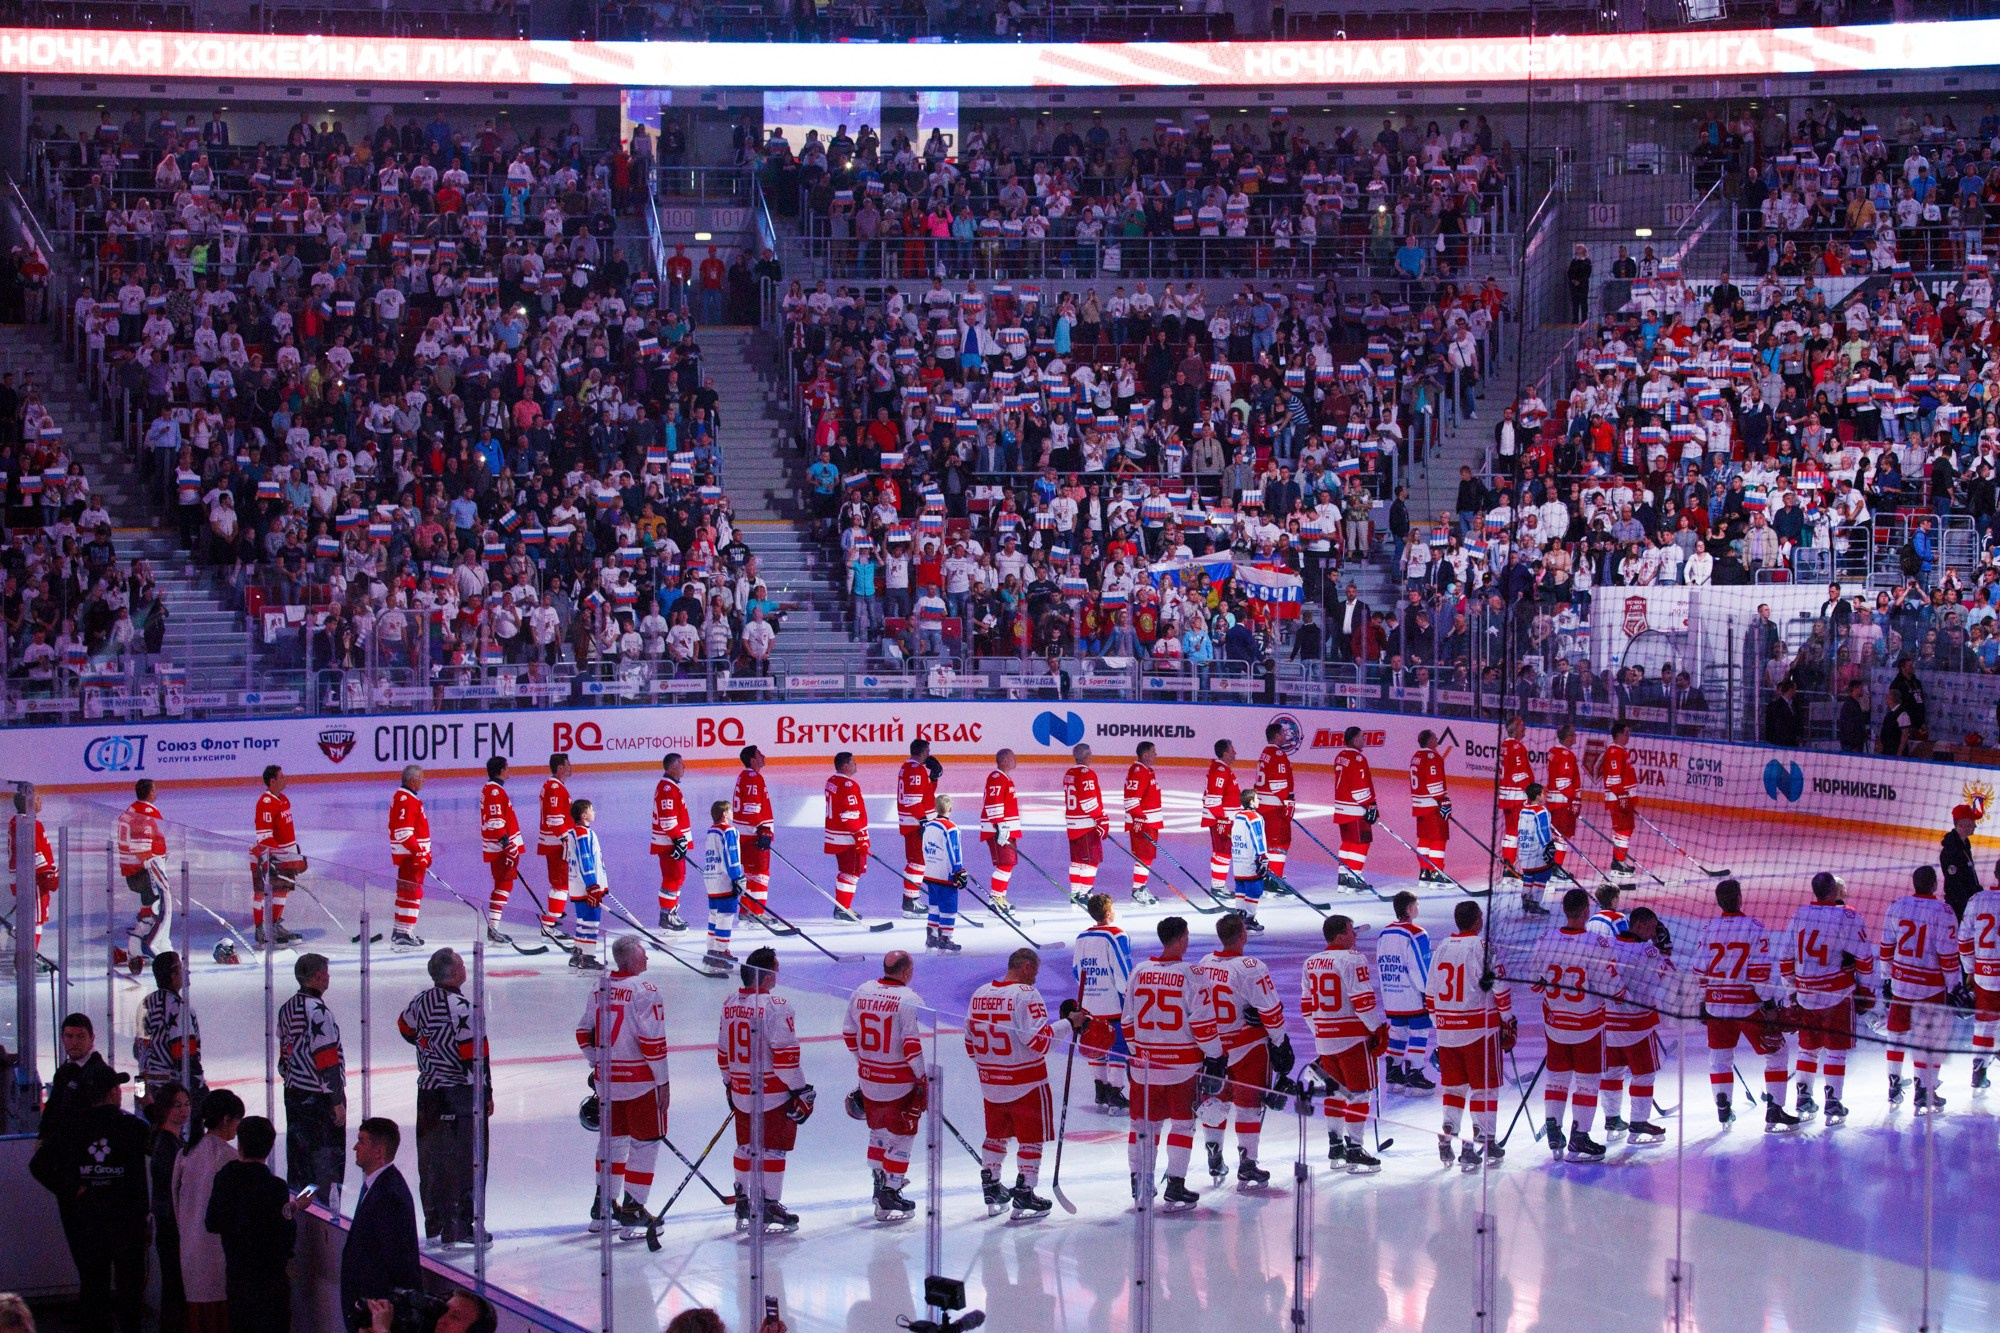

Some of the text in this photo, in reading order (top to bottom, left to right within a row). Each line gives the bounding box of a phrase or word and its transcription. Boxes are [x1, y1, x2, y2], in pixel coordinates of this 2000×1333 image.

[2, 36, 520, 75] НОЧНАЯ ХОККЕЙНАЯ ЛИГА
[1244, 36, 1765, 77] НОЧНАЯ ХОККЕЙНАЯ ЛИГА
[664, 210, 694, 227] 100
[714, 210, 740, 226] 101
[1591, 205, 1616, 222] 101
[1246, 582, 1297, 602] СОЧИ
[321, 730, 355, 743] СПОРТ
[553, 721, 603, 752] BQ
[696, 717, 746, 747] BQ
[774, 715, 983, 744] Вятский квас
[1096, 723, 1196, 739] НОРНИКЕЛЬ
[1312, 728, 1385, 748] ARIC
[156, 736, 281, 752] Союз Флот Порт
[374, 721, 514, 763] СПОРТ FM
[606, 735, 694, 752] СМАРТФОНЫ
[157, 753, 237, 763] УСЛУГИ БУКСИРОВ
[1629, 747, 1679, 769] ОЧНАЯ
[1278, 763, 1286, 773] 16
[1429, 765, 1437, 776] 6
[909, 775, 922, 786] 28
[1082, 780, 1096, 791] 26
[1126, 780, 1139, 791] 23
[1215, 777, 1225, 788] 18
[1639, 768, 1665, 787] ИГА
[1686, 773, 1724, 788] 2017/18
[746, 785, 758, 795] 76
[989, 786, 1002, 797] 27
[1813, 777, 1897, 801] НОРНИКЕЛЬ
[660, 799, 674, 810] 89
[847, 795, 858, 806] 51
[262, 811, 272, 823] 10
[399, 809, 406, 820] 2
[489, 804, 502, 815] 93
[1898, 919, 1927, 959] 21
[1948, 925, 1956, 939] 2
[1976, 913, 2000, 949] 2
[1760, 938, 1769, 953] 2
[1797, 928, 1828, 967] 14
[1709, 941, 1750, 979] 27
[1138, 972, 1184, 988] ИВЕНЦОВ
[1256, 975, 1274, 995] 76
[1437, 962, 1465, 1002] 31
[1546, 964, 1586, 1003] 33
[856, 998, 900, 1013] ПОТАНИН
[1028, 1003, 1048, 1020] 55
[1134, 988, 1183, 1031] 25
[860, 1012, 893, 1054] 61
[970, 1013, 1012, 1057] 55
[728, 1021, 751, 1064] 19
[80, 1165, 125, 1176] MF Group
